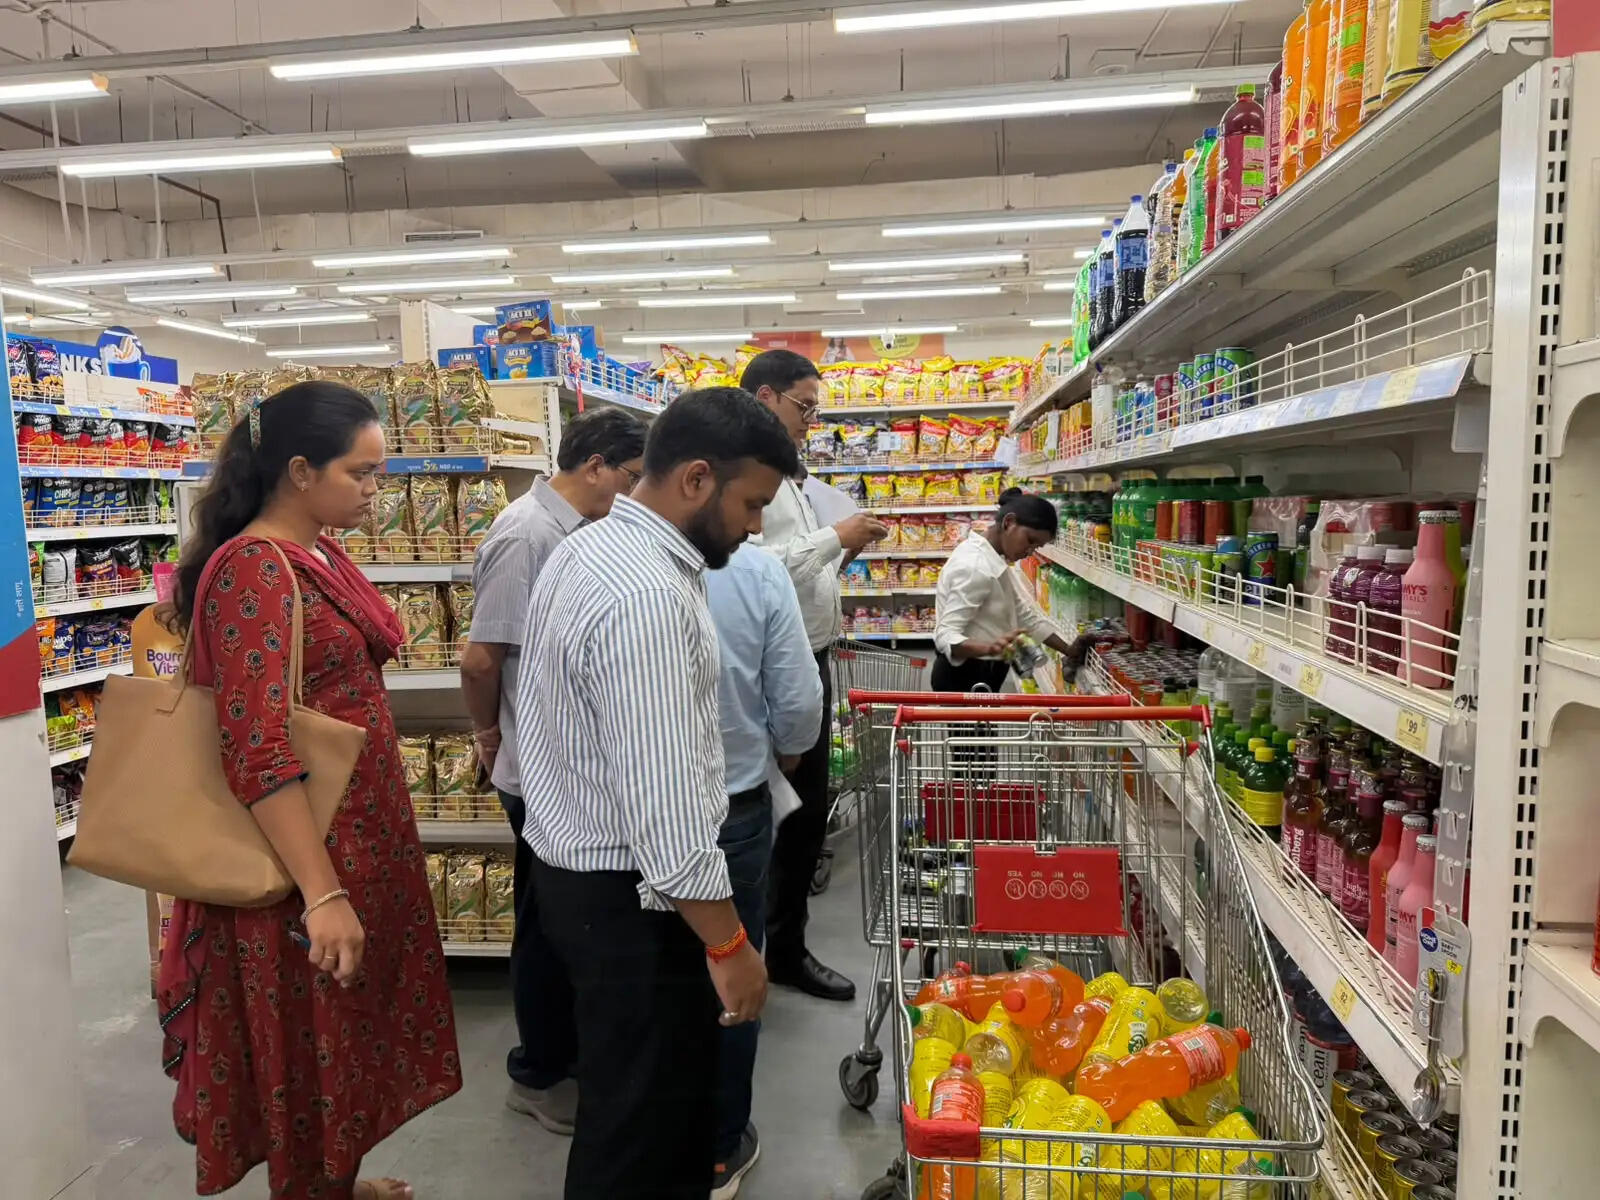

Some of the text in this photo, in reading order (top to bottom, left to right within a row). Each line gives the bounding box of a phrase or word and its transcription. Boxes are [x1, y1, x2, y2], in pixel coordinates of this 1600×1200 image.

[60, 352, 103, 376] NKS
[423, 459, 438, 472] 5%
[54, 488, 72, 499] CHIPS
[1402, 584, 1427, 596] MY'S
[152, 660, 180, 676] Vita
